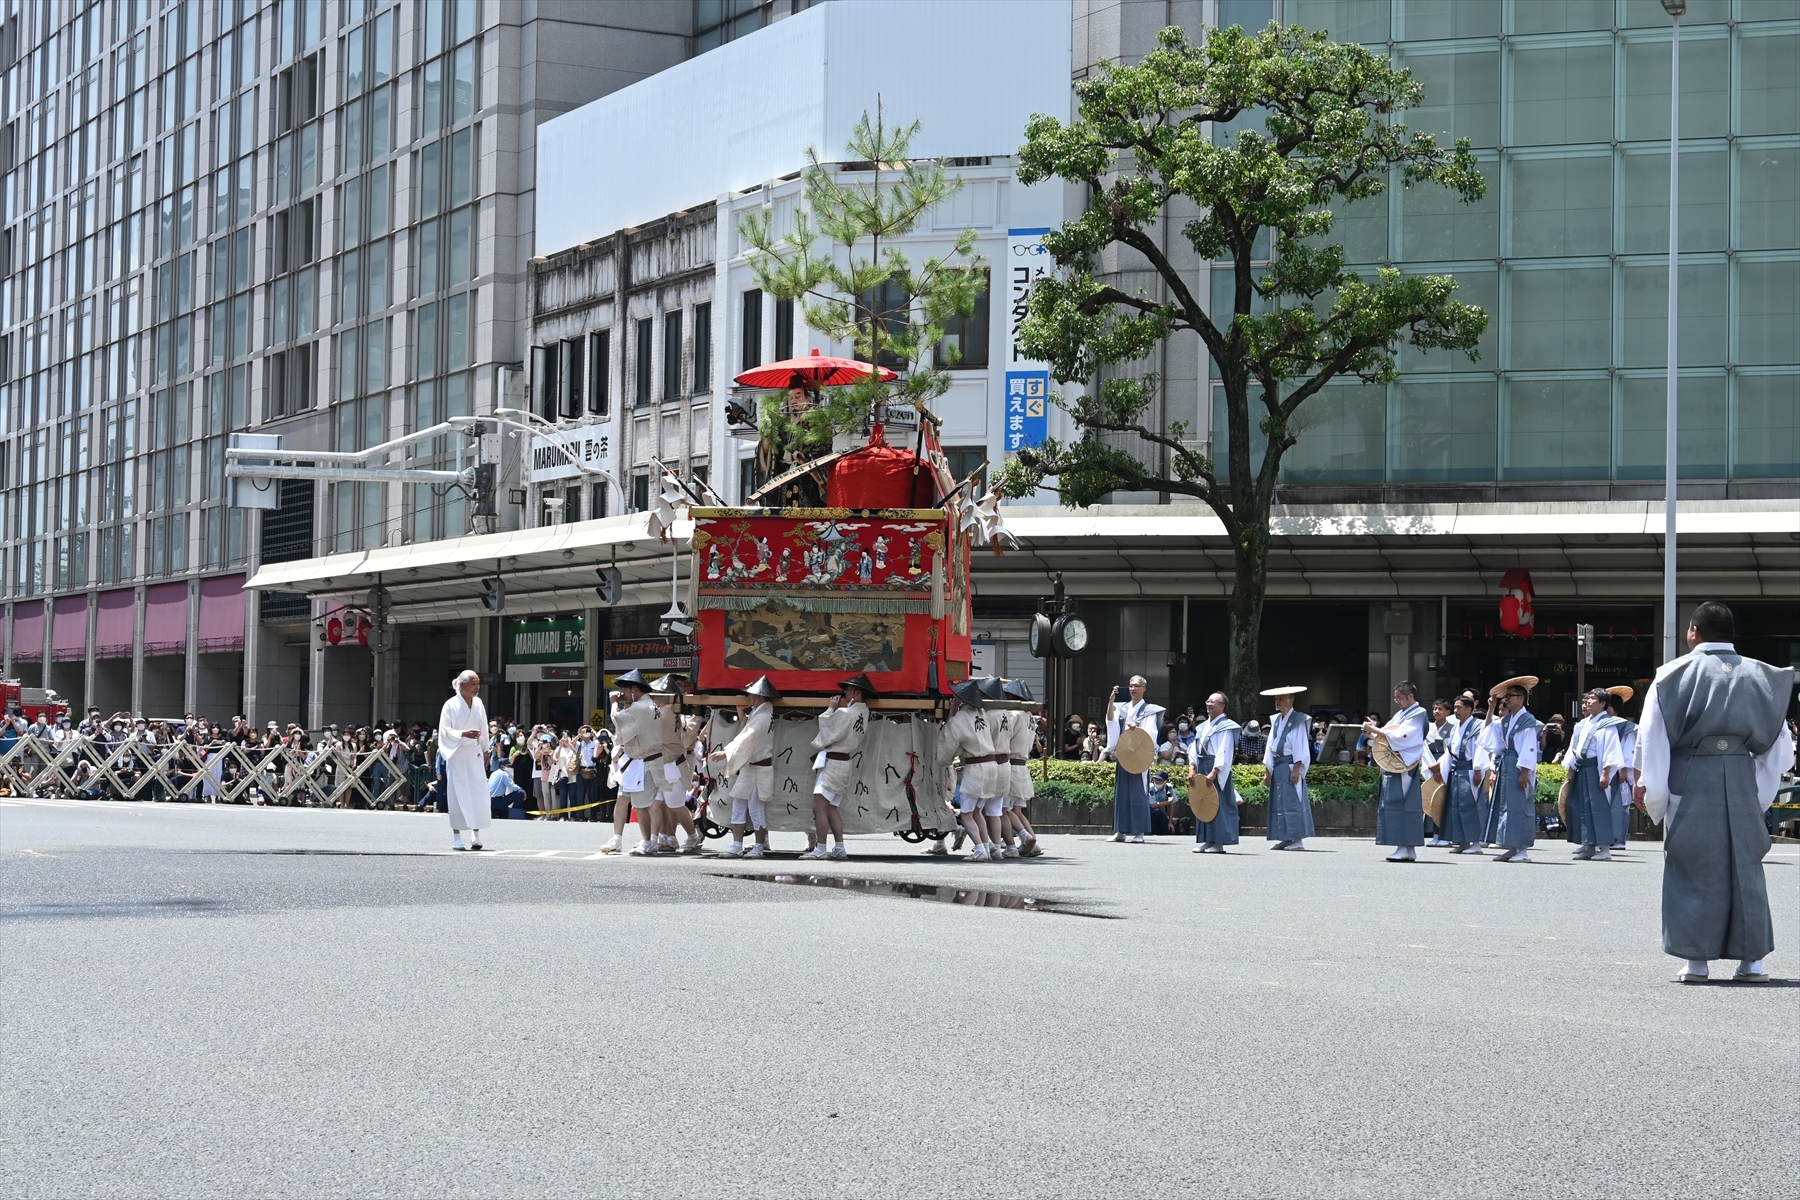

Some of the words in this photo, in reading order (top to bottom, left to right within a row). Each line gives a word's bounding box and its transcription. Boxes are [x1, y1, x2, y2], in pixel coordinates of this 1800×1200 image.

[1028, 379, 1043, 416] すぐ
[1008, 378, 1026, 449] 買えます
[584, 435, 609, 462] 雲の茶
[514, 630, 560, 655] MARUMARU
[564, 629, 586, 653] 雲の茶
[615, 642, 674, 656] アクセスチケット
[679, 657, 691, 667] TICKE
[1567, 664, 1628, 674] Taashimaya
